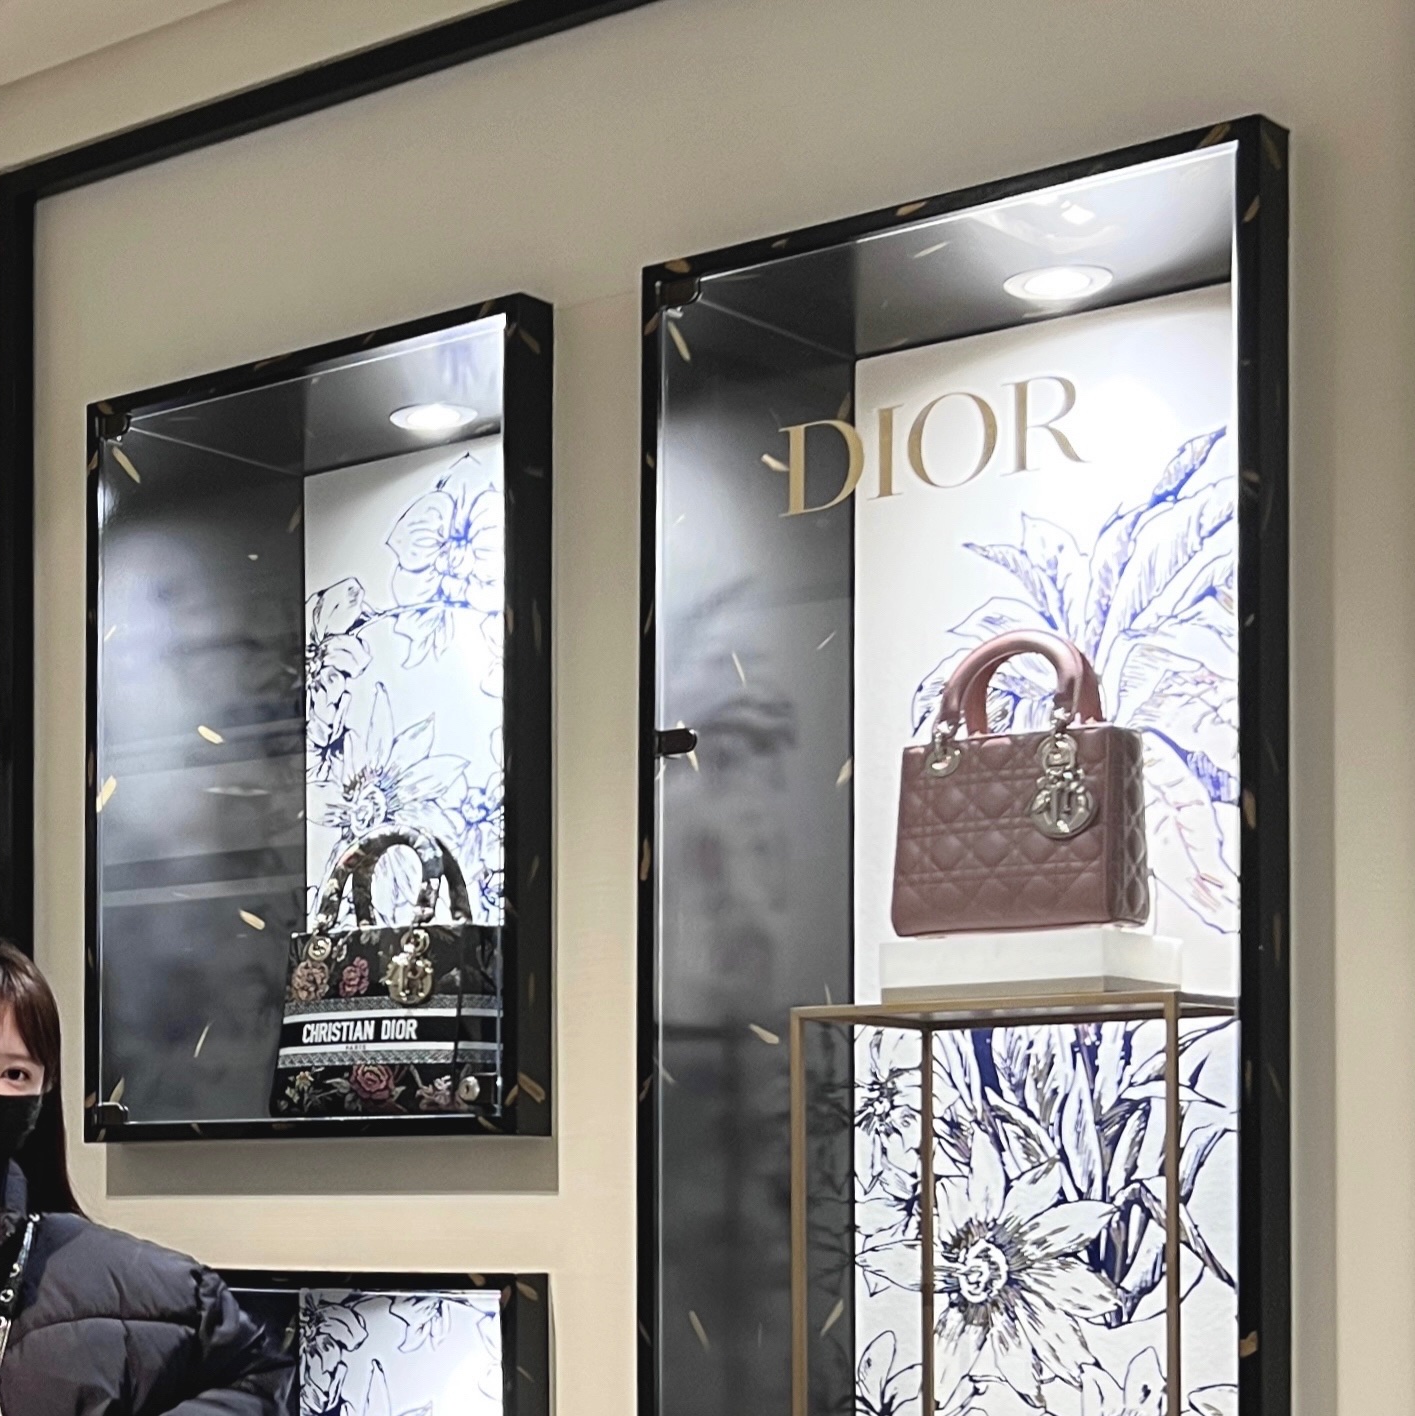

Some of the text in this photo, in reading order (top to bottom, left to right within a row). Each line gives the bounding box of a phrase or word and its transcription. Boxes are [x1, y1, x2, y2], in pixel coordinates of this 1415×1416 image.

[778, 375, 1091, 518] DIOR
[301, 1018, 418, 1044] CHRISTIAN DIOR
